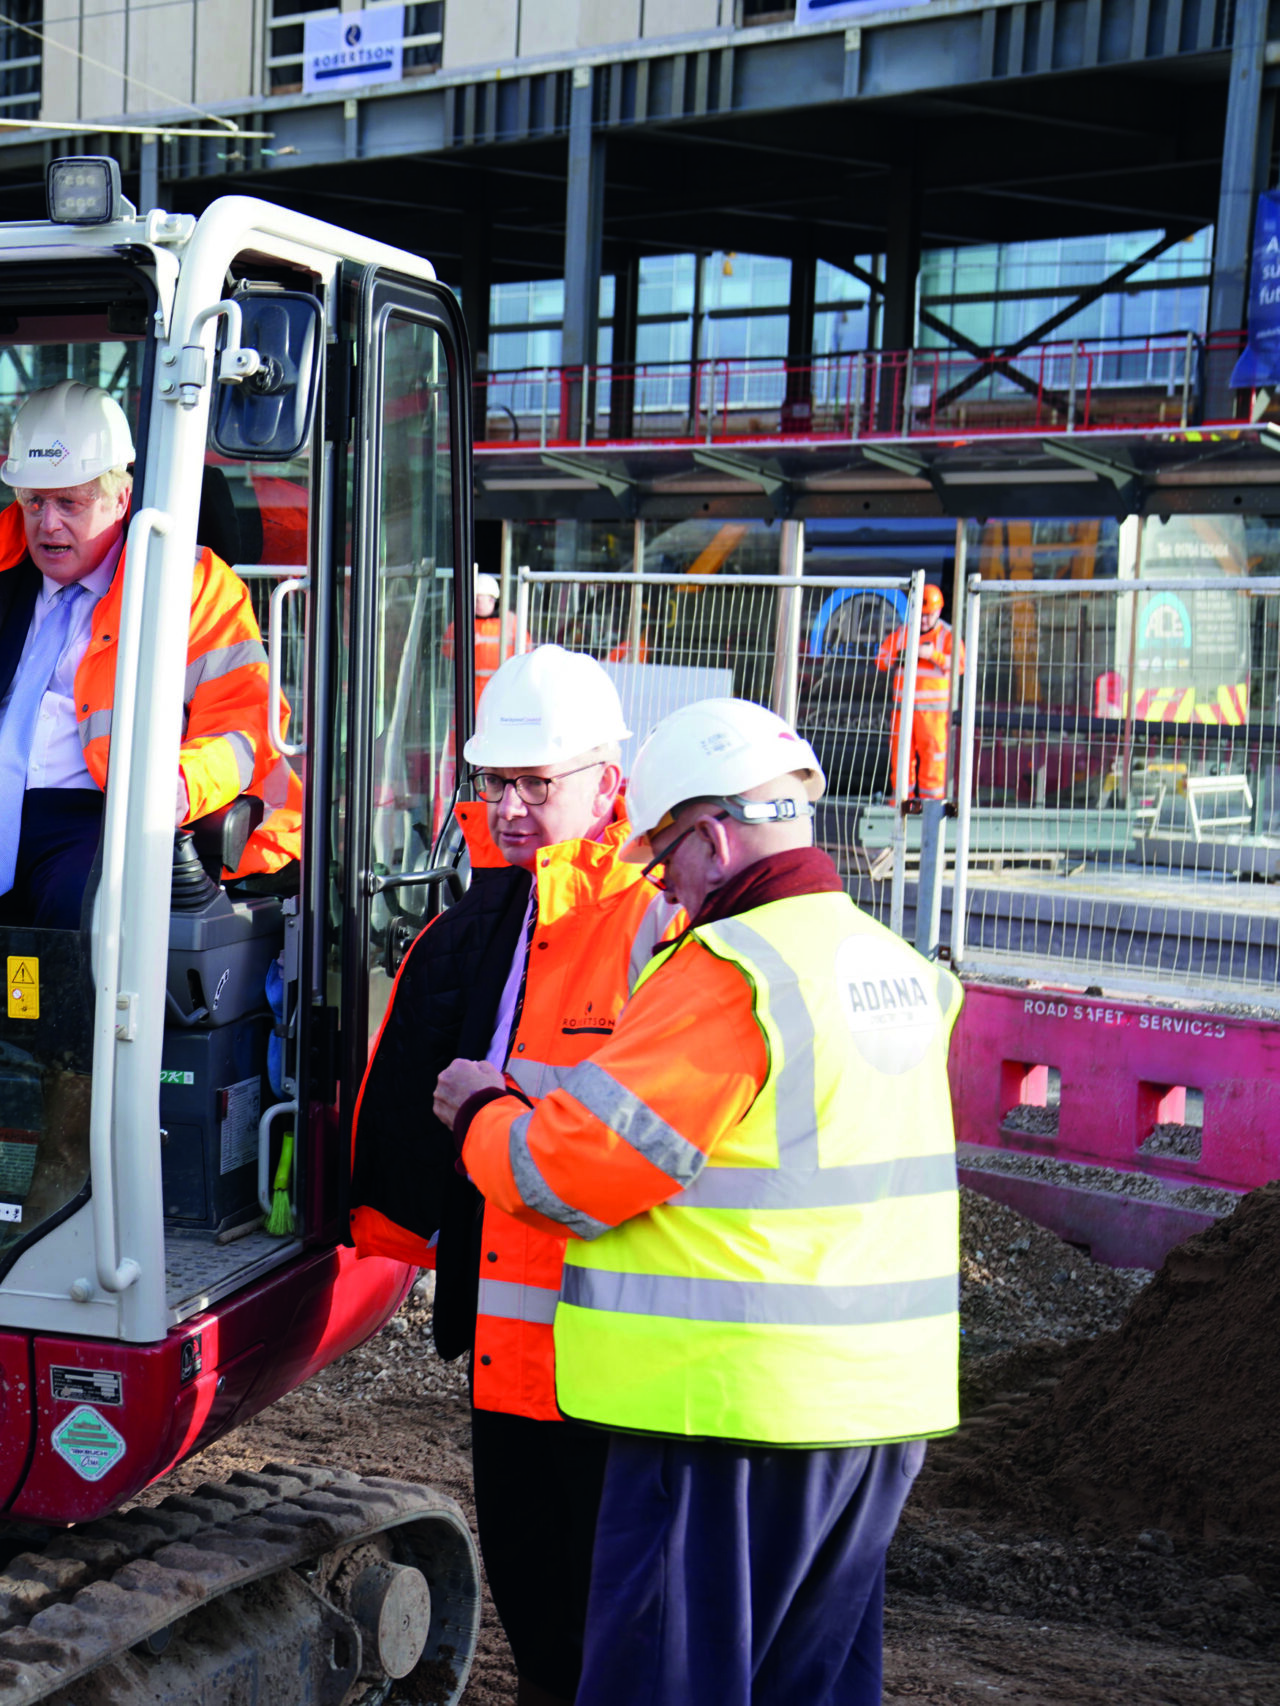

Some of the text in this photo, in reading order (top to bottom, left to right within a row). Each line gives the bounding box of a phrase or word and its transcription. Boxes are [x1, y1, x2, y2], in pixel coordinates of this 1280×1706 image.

[313, 46, 395, 67] ROBERTSON
[28, 448, 63, 458] muse
[848, 977, 928, 1013] ADANA
[1024, 999, 1068, 1018] ROAD
[1073, 1005, 1132, 1027] SAFET
